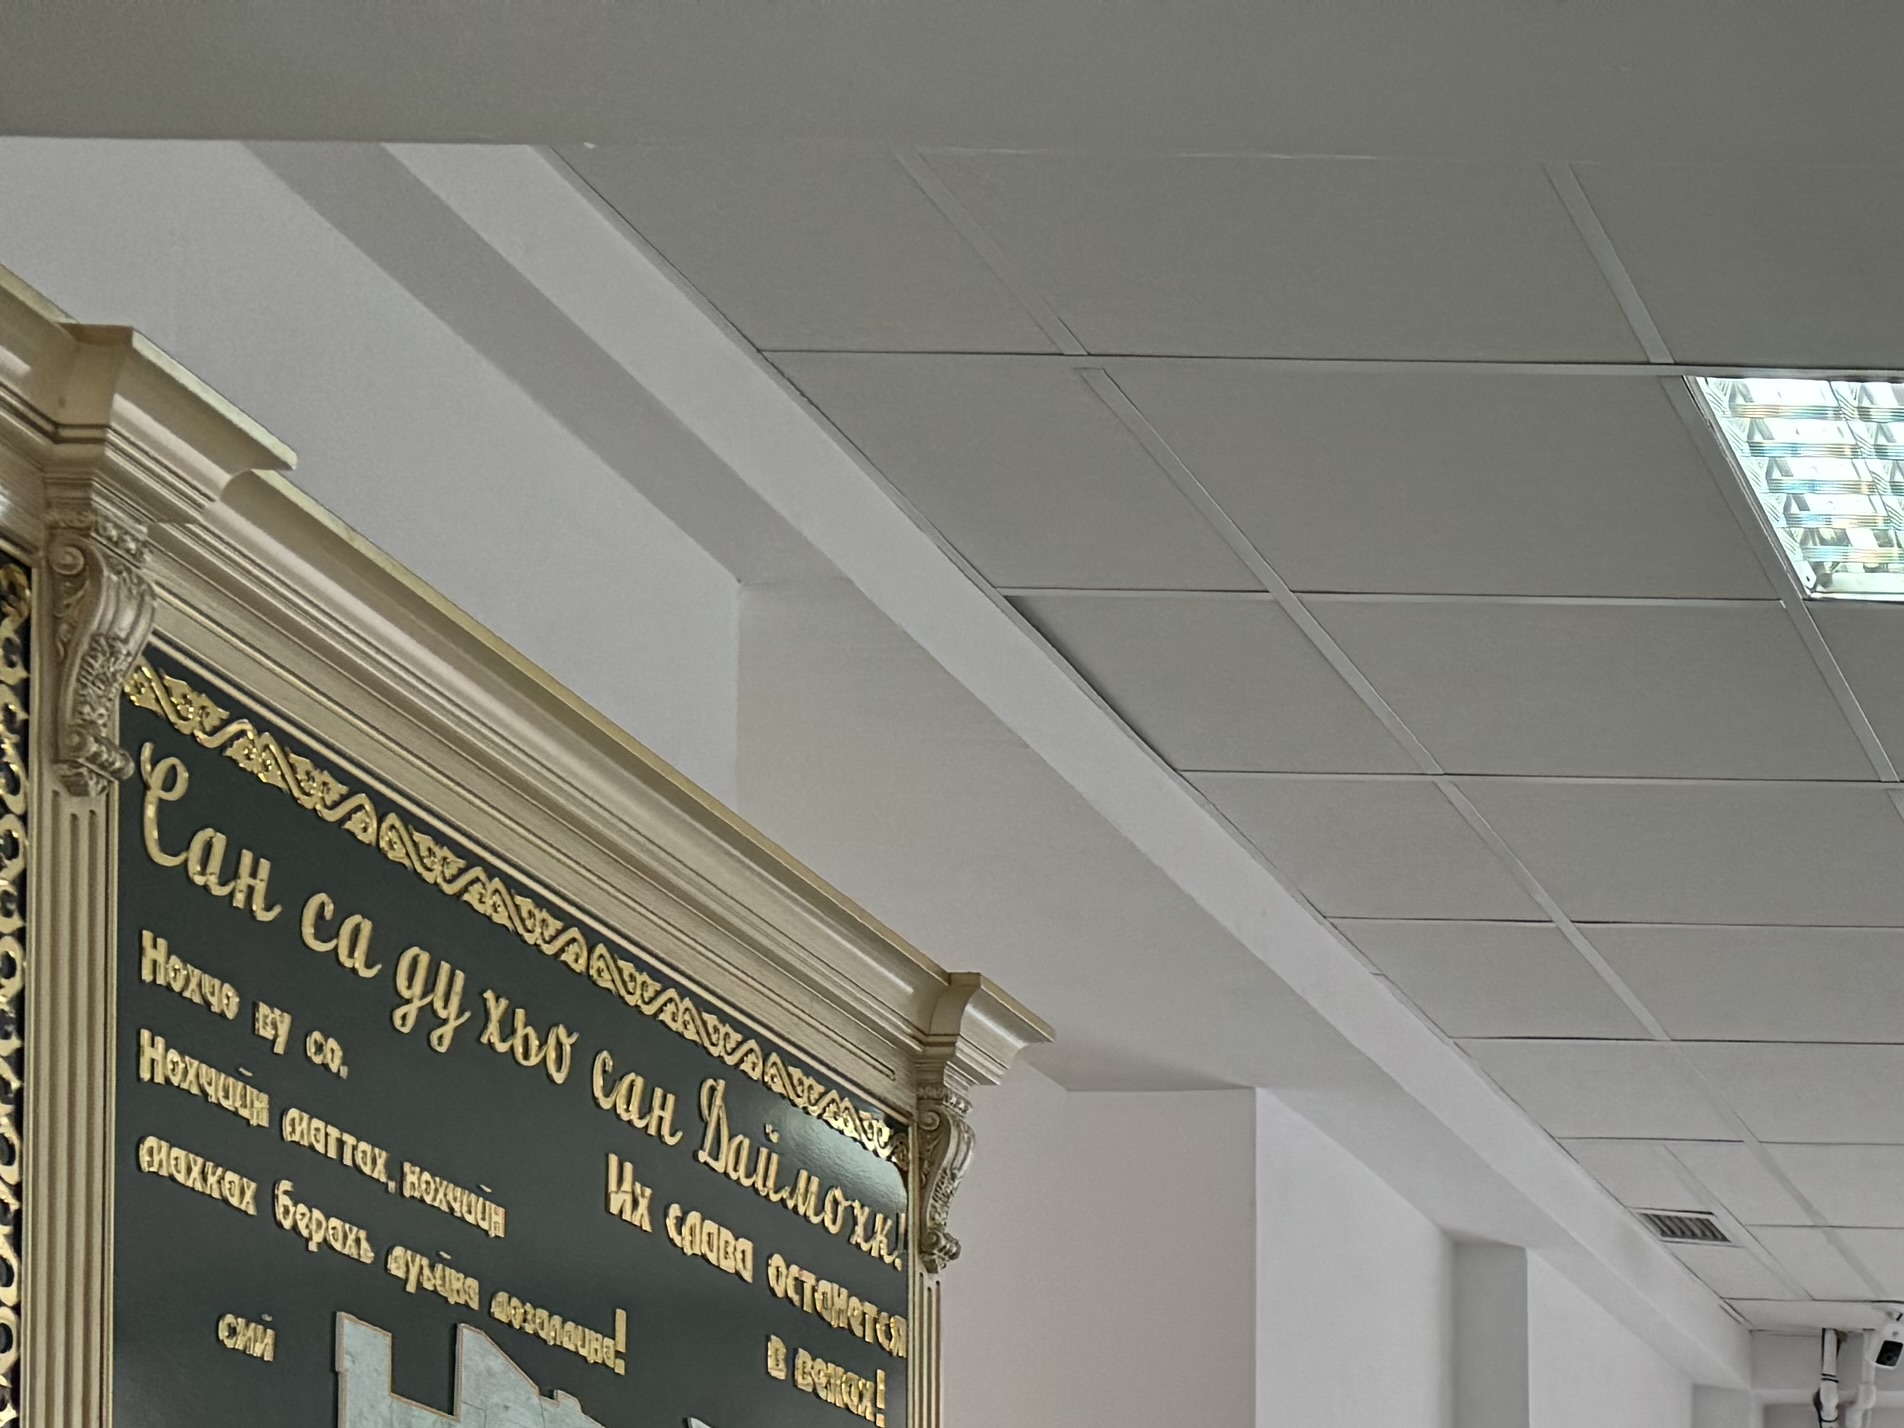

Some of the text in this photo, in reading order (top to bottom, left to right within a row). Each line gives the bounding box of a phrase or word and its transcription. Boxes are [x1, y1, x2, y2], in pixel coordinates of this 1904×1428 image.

[140, 742, 282, 922] Сан
[301, 892, 382, 978] са
[393, 946, 471, 1053] ду
[480, 989, 579, 1084] хьо
[141, 930, 240, 1020] Нохчо
[139, 1028, 269, 1127] Нохчийн
[402, 1161, 506, 1238] нохчийн
[607, 1152, 907, 1358] Их слава останется
[217, 1313, 276, 1361] СИЙ
[767, 1334, 886, 1428] в веках!
